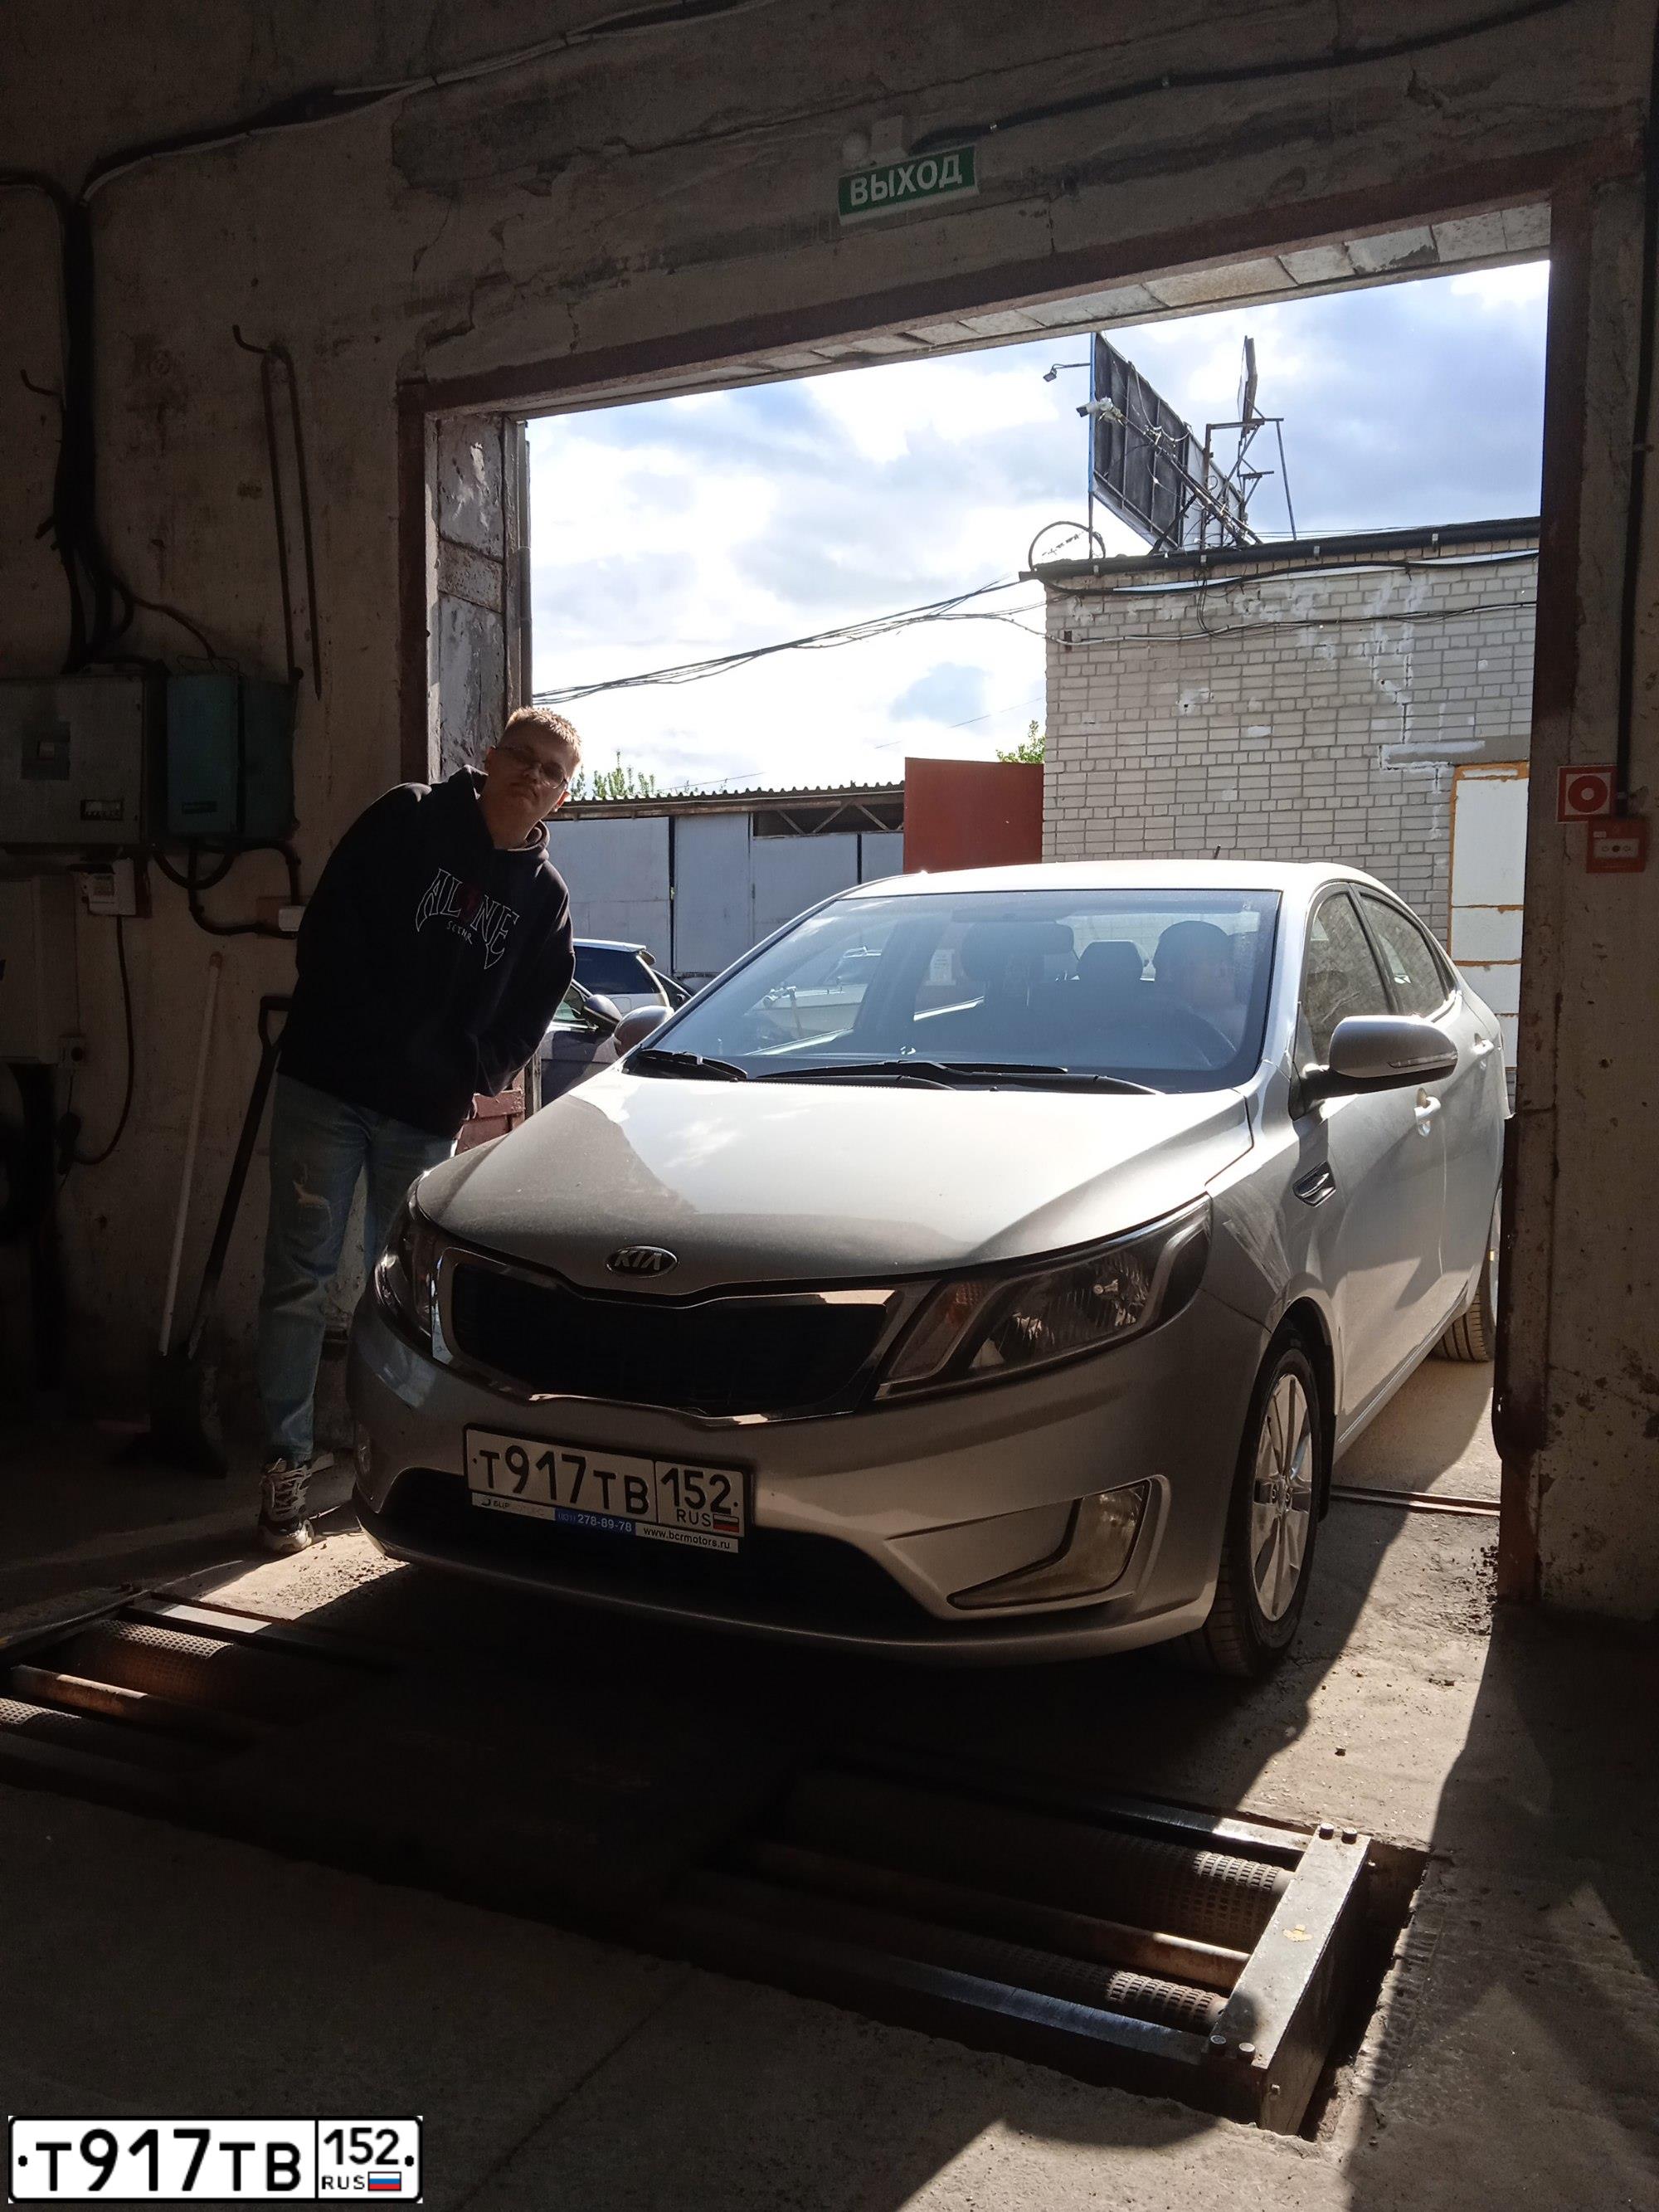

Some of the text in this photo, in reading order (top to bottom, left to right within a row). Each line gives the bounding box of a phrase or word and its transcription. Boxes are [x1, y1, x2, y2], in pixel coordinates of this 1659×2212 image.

[850, 154, 962, 206] ВЫХОД
[479, 1445, 731, 1515] Т917ТВ 152
[577, 1513, 632, 1532] 278-89-78
[676, 1509, 712, 1527] RUS
[643, 1527, 730, 1549] www.bcrmotors.ru
